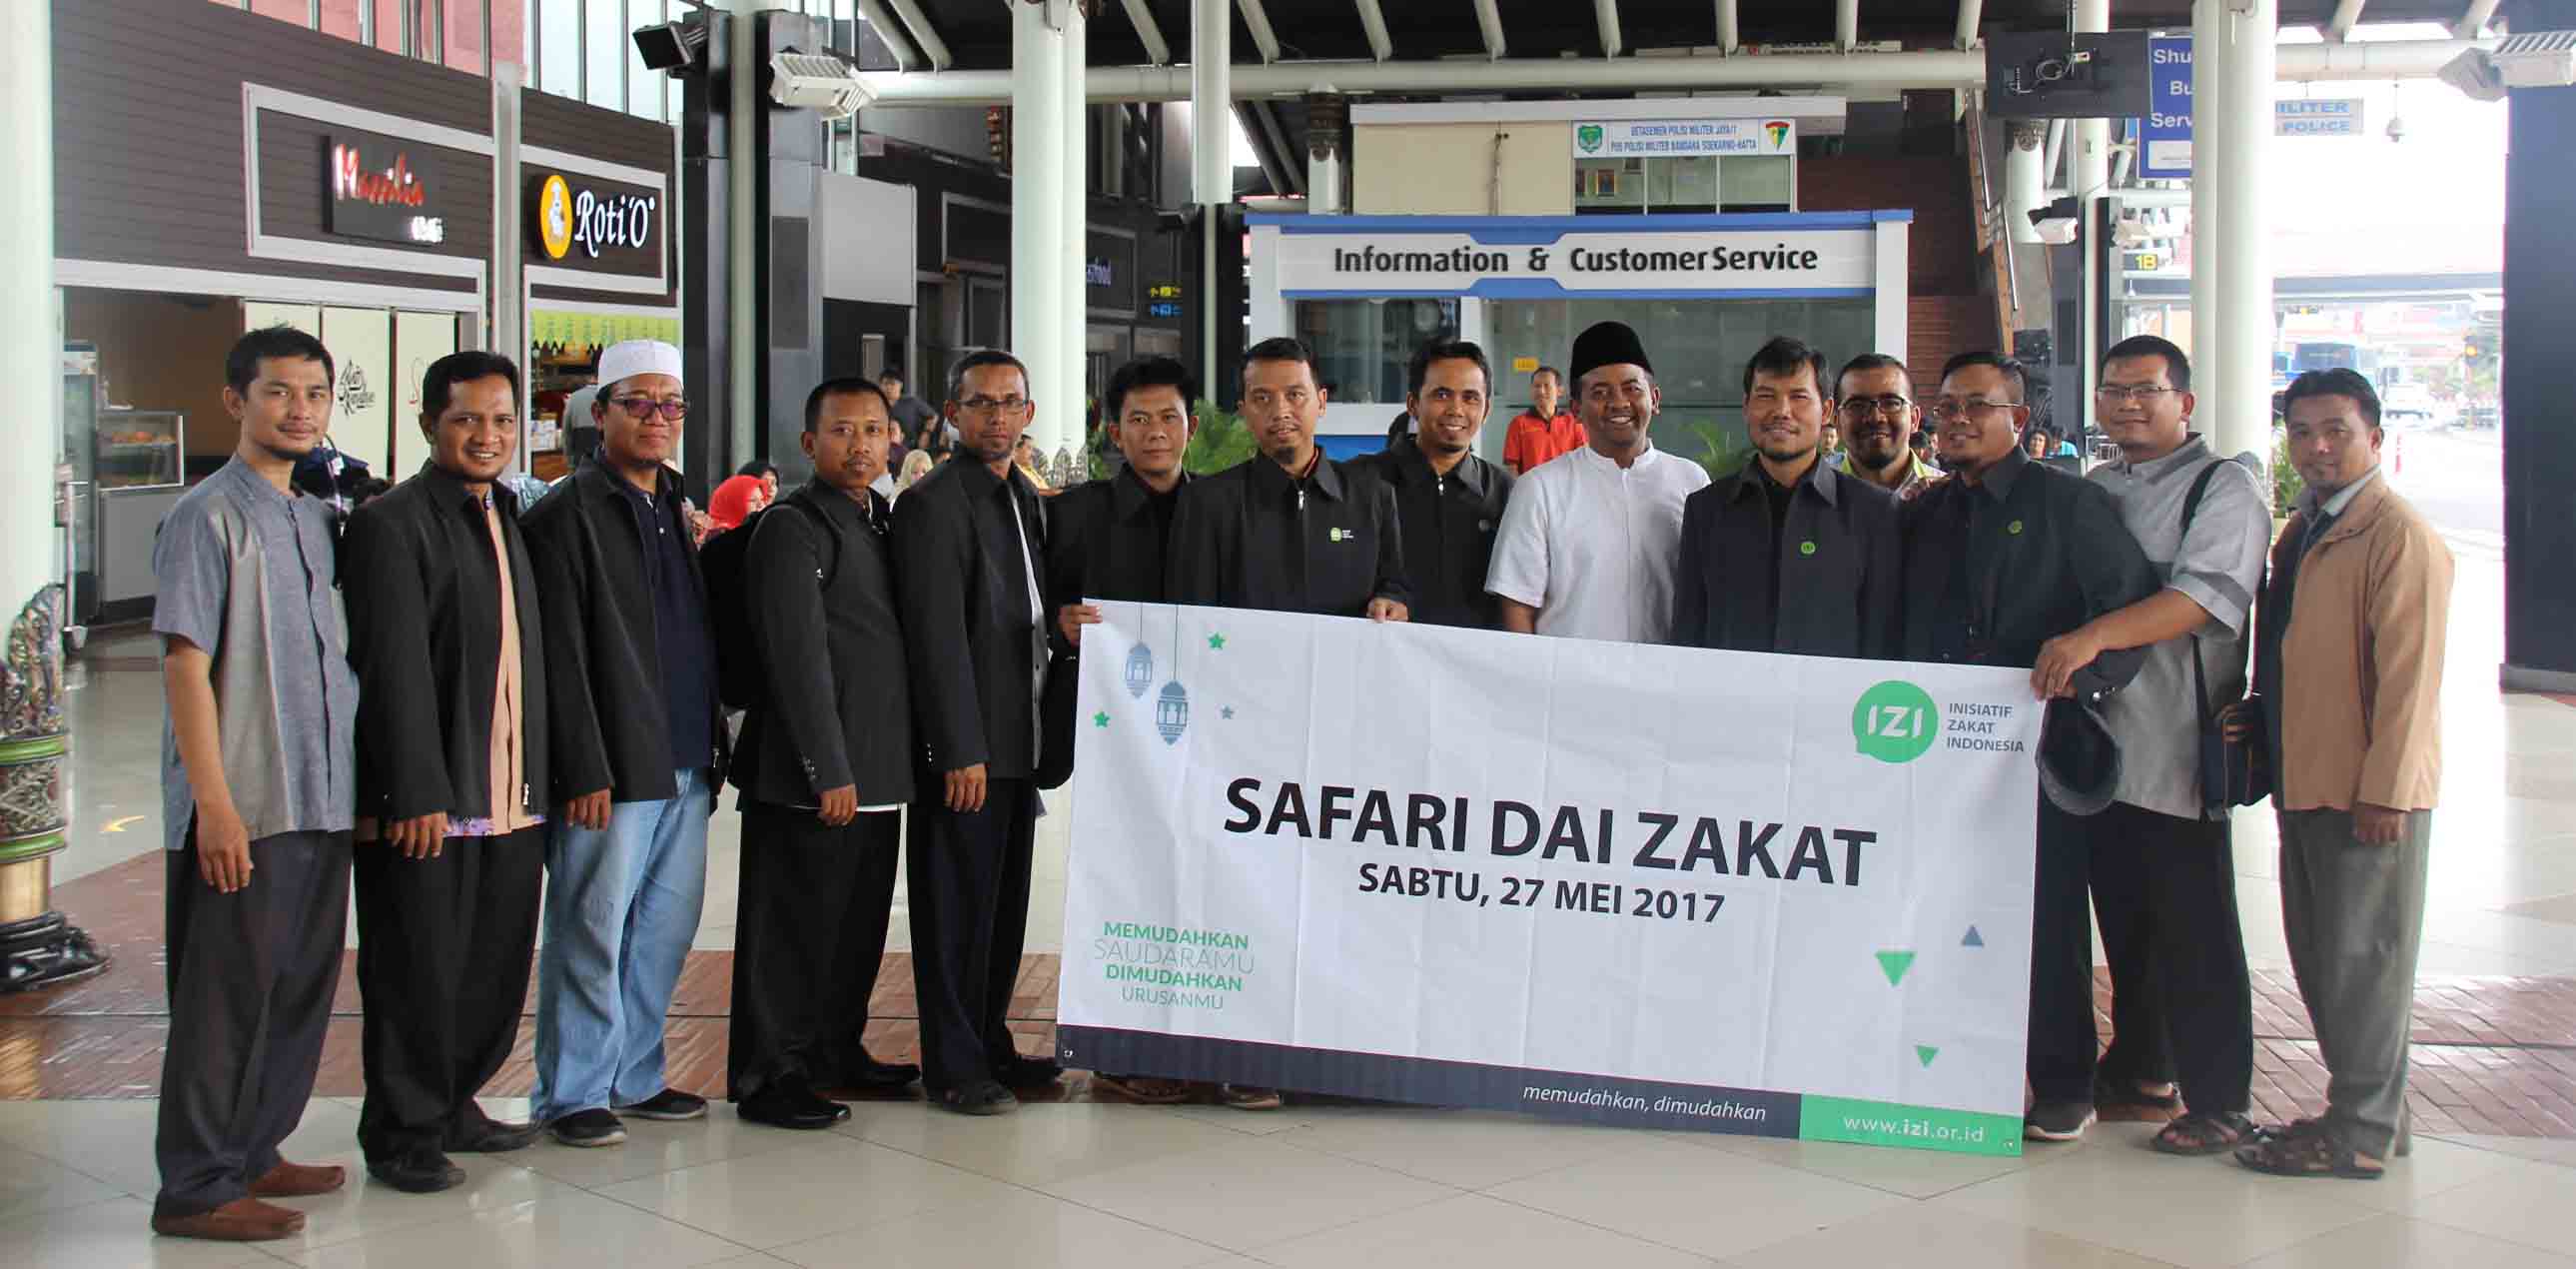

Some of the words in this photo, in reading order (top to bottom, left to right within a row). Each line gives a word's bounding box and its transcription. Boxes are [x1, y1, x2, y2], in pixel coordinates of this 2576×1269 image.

[2153, 49, 2192, 64] Shu
[2169, 81, 2193, 96] Bu
[2150, 112, 2192, 128] Serv
[2278, 102, 2349, 113] ILITER
[1334, 245, 1509, 273] Information
[1528, 247, 1550, 273] &
[1570, 248, 1709, 273] Customer
[1712, 243, 1818, 271] Service
[1867, 703, 1923, 739] IZI
[1949, 702, 2013, 717] INISIATIF
[1948, 718, 1996, 734] ZAKAT
[1947, 736, 2025, 752] INDONESIA
[1224, 777, 1468, 852] SAFARI
[1490, 800, 1614, 864] DAI
[1632, 811, 1877, 887] ZAKAT
[1357, 862, 1489, 907] SABTU,
[1499, 877, 1544, 907] 27
[1554, 880, 1622, 914] MEI
[1632, 887, 1726, 922] 2017
[1104, 921, 1249, 949] MEMUDAHKAN
[1094, 938, 1256, 974] SAUDARAMU
[1106, 964, 1243, 992] DIMUDAHKAN
[1122, 985, 1224, 1009] URUSANMU
[1522, 1085, 1649, 1112] memudahkan,
[1653, 1095, 1767, 1121] dimudahkan
[1844, 1116, 1985, 1143] www.izi.or.id
